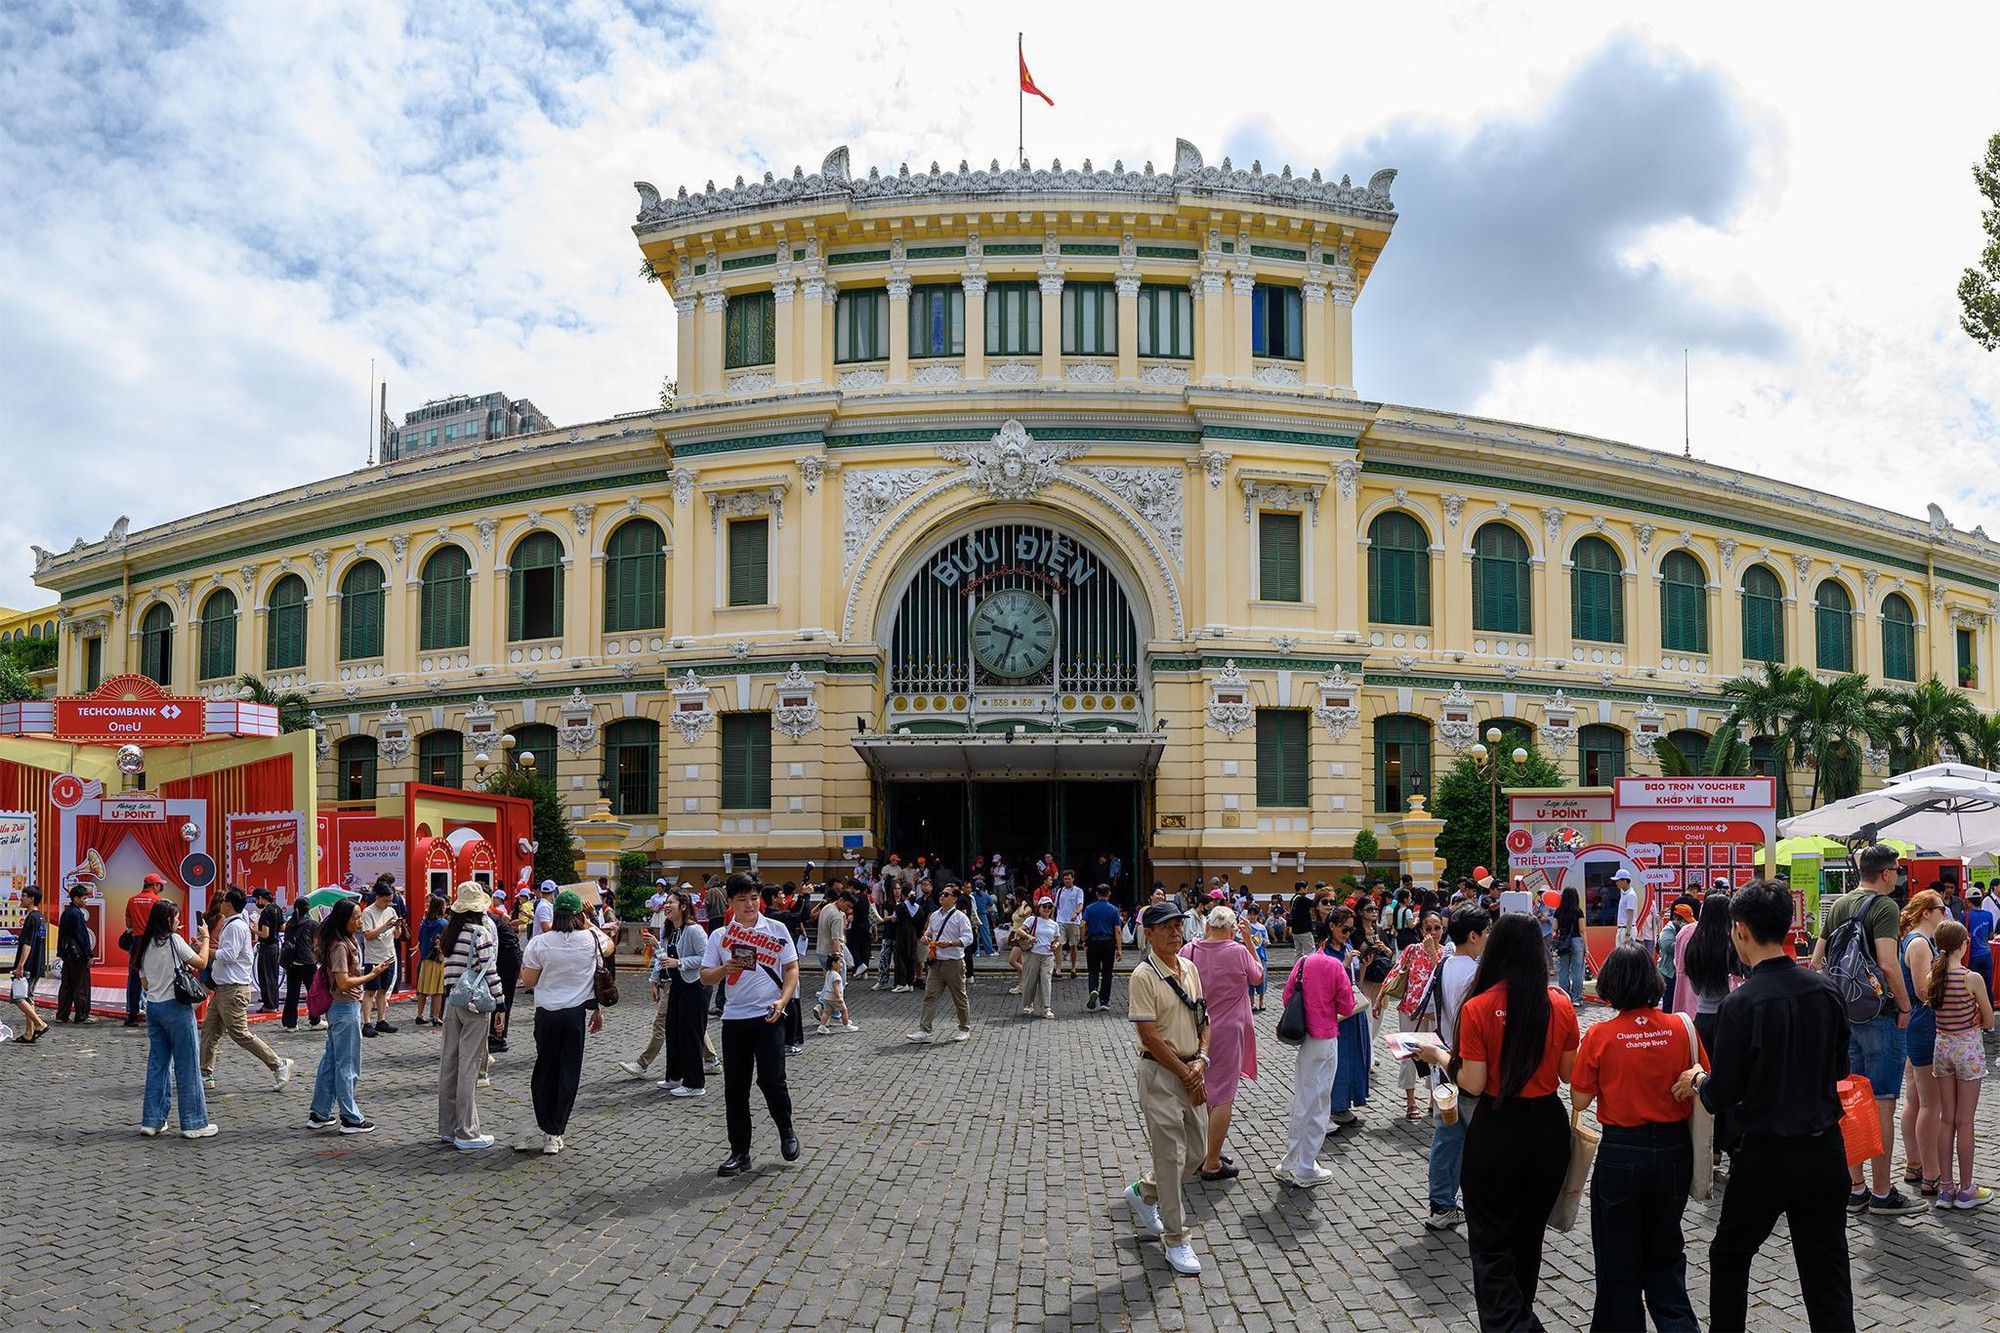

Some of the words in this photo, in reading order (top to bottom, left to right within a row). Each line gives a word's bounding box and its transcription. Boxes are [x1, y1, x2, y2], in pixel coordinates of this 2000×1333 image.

[931, 535, 1000, 588] BƯU
[1016, 534, 1096, 588] ĐIỆN
[78, 707, 156, 716] TECHCOMBANK
[108, 722, 141, 732] OneU
[62, 786, 74, 798] U
[1668, 783, 1694, 792] TRỌN
[1537, 807, 1588, 818] U-POINT
[1515, 838, 1525, 848] U
[1514, 853, 1546, 868] TRIỆU
[728, 924, 782, 953] Haidilao
[1617, 1031, 1644, 1040] Change
[1644, 1028, 1673, 1039] banking
[1625, 1040, 1651, 1049] change
[1652, 1038, 1668, 1047] lives
